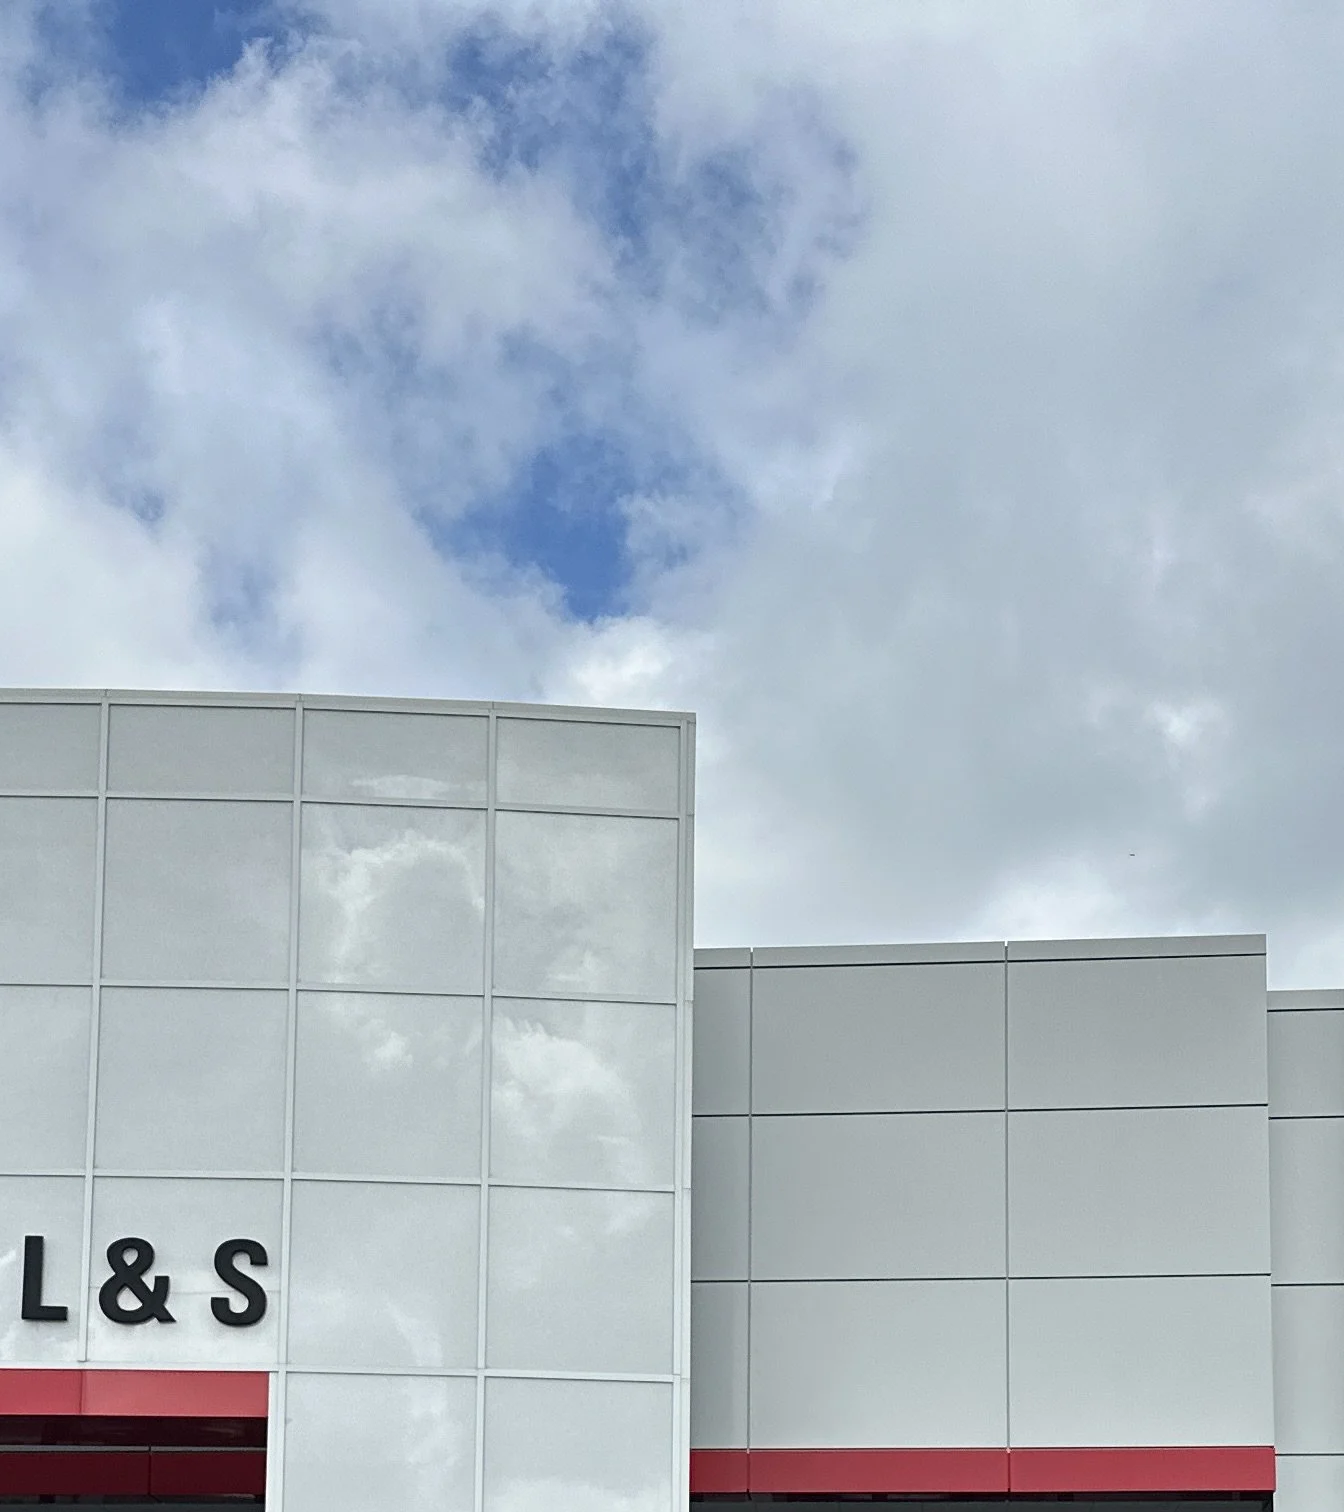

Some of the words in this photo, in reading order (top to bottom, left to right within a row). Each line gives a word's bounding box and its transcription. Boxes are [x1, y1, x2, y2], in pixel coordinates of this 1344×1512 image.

[22, 1235, 68, 1320] L
[98, 1237, 177, 1325] &
[211, 1239, 268, 1326] S
